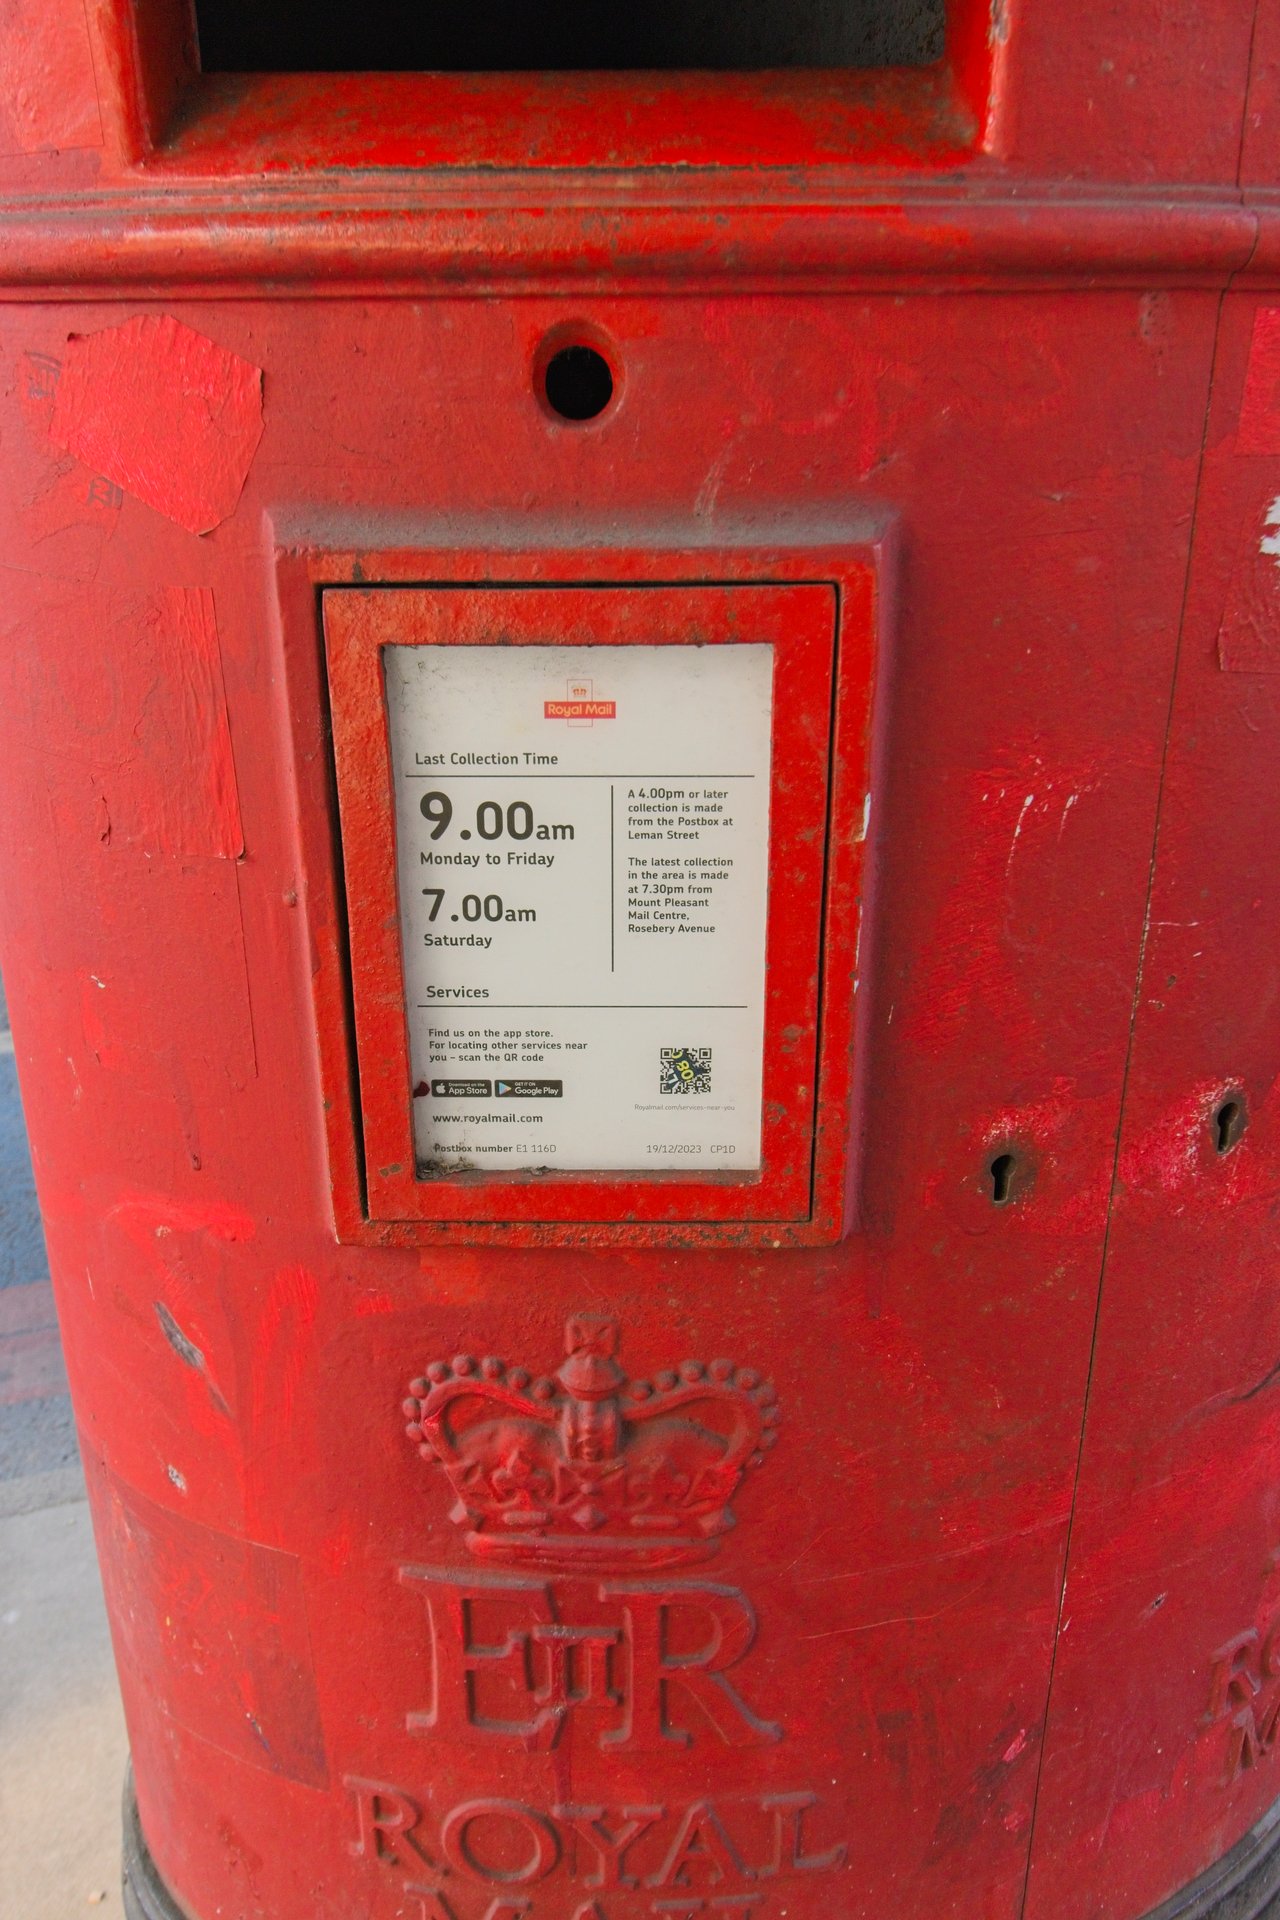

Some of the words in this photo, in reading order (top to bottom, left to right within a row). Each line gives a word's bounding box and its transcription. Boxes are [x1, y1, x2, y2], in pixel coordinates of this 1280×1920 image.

[547, 703, 582, 717] Royal
[585, 703, 612, 715] Mail
[415, 752, 446, 765] Last
[450, 752, 518, 765] Collection
[523, 753, 558, 765] Time
[628, 789, 635, 798] A
[638, 788, 684, 800] 4.00pm
[704, 790, 728, 798] later
[628, 803, 678, 812] collection
[682, 803, 690, 812] is
[694, 803, 723, 812] made
[419, 791, 574, 841] 9.00am
[628, 817, 653, 826] from
[657, 817, 674, 826] the
[678, 817, 719, 826] Postbox
[722, 818, 733, 826] at
[628, 830, 663, 839] Leman
[667, 830, 699, 839] Street
[419, 851, 480, 868] Monday
[485, 853, 501, 865] to
[507, 852, 554, 868] Friday
[628, 857, 647, 866] The
[651, 857, 680, 866] latest
[684, 857, 733, 866] collection
[628, 870, 637, 879] in
[641, 871, 658, 879] the
[688, 870, 697, 879] is
[701, 871, 729, 879] made
[628, 886, 638, 894] at
[642, 884, 684, 895] 7.30pm
[688, 885, 712, 894] from
[421, 888, 536, 922] 7.00am
[628, 898, 661, 907] Mount
[665, 898, 709, 907] Pleasant
[628, 911, 649, 920] Mail
[653, 911, 689, 920] Centre,
[628, 924, 675, 934] Rosebery
[678, 924, 715, 933] Avenue
[423, 933, 492, 949] Saturday
[426, 985, 489, 998] Services
[428, 1029, 450, 1037] Find
[484, 1029, 500, 1037] the
[504, 1031, 522, 1039] app
[429, 1041, 446, 1049] For
[448, 1041, 488, 1051] locating
[491, 1041, 518, 1049] other
[521, 1041, 561, 1049] services
[429, 1055, 447, 1063] you
[484, 1053, 500, 1061] the
[504, 1053, 518, 1061] QR
[521, 1053, 544, 1061] code
[449, 1087, 465, 1095] App
[466, 1087, 488, 1095] Store
[515, 1087, 543, 1096] Google
[543, 1087, 559, 1096] Play
[432, 1113, 543, 1125] www.royalmail.com
[434, 1143, 472, 1153] Postbox
[646, 1144, 701, 1154] 19/12/2023
[343, 1773, 848, 1890] ROYAL
